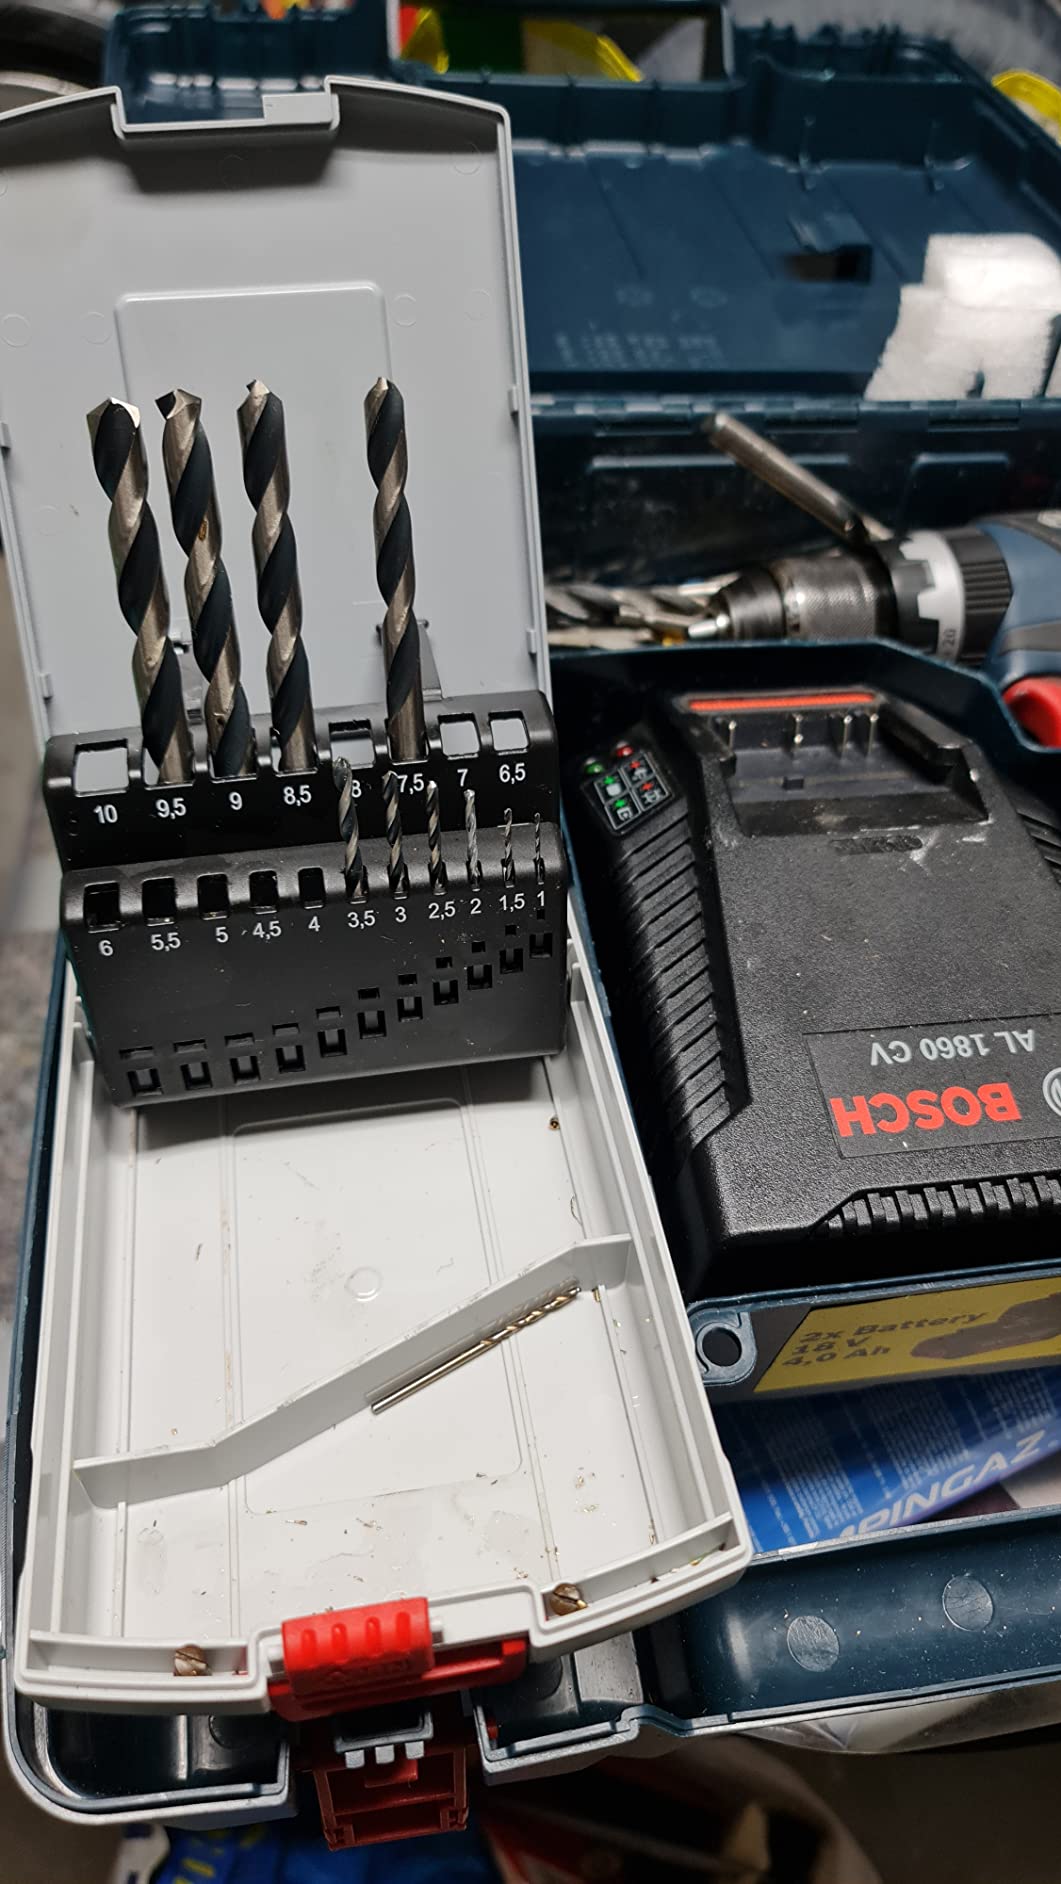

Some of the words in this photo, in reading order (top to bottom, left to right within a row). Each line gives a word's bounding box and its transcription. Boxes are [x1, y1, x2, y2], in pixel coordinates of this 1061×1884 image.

[93, 804, 118, 825] 10
[156, 797, 188, 820] 9,5
[228, 791, 243, 811] 9
[283, 785, 313, 808] 8,5
[351, 779, 362, 798] 8
[397, 773, 425, 796] 7,5
[457, 768, 469, 787] 7
[499, 762, 526, 785] 6,5
[98, 938, 114, 957] 6
[150, 931, 181, 953] 5,5
[215, 925, 230, 944] 5
[252, 919, 282, 941] 4,5
[308, 915, 321, 933] 4
[347, 909, 376, 931] 3,5
[394, 905, 407, 924] 3
[428, 900, 456, 922] 2,5
[469, 896, 482, 915] 2
[499, 893, 526, 914] 1,5
[536, 890, 546, 908] 1
[870, 1039, 912, 1067] CV
[919, 1035, 990, 1061] 1860
[993, 1028, 1035, 1053] AL
[830, 1082, 1023, 1138] BOSCH
[799, 1330, 843, 1344] 2x
[852, 1311, 989, 1337] Battery
[781, 1352, 837, 1368] 4,0
[843, 1345, 891, 1358] Ah
[791, 1342, 835, 1356] 18
[846, 1335, 872, 1348] V
